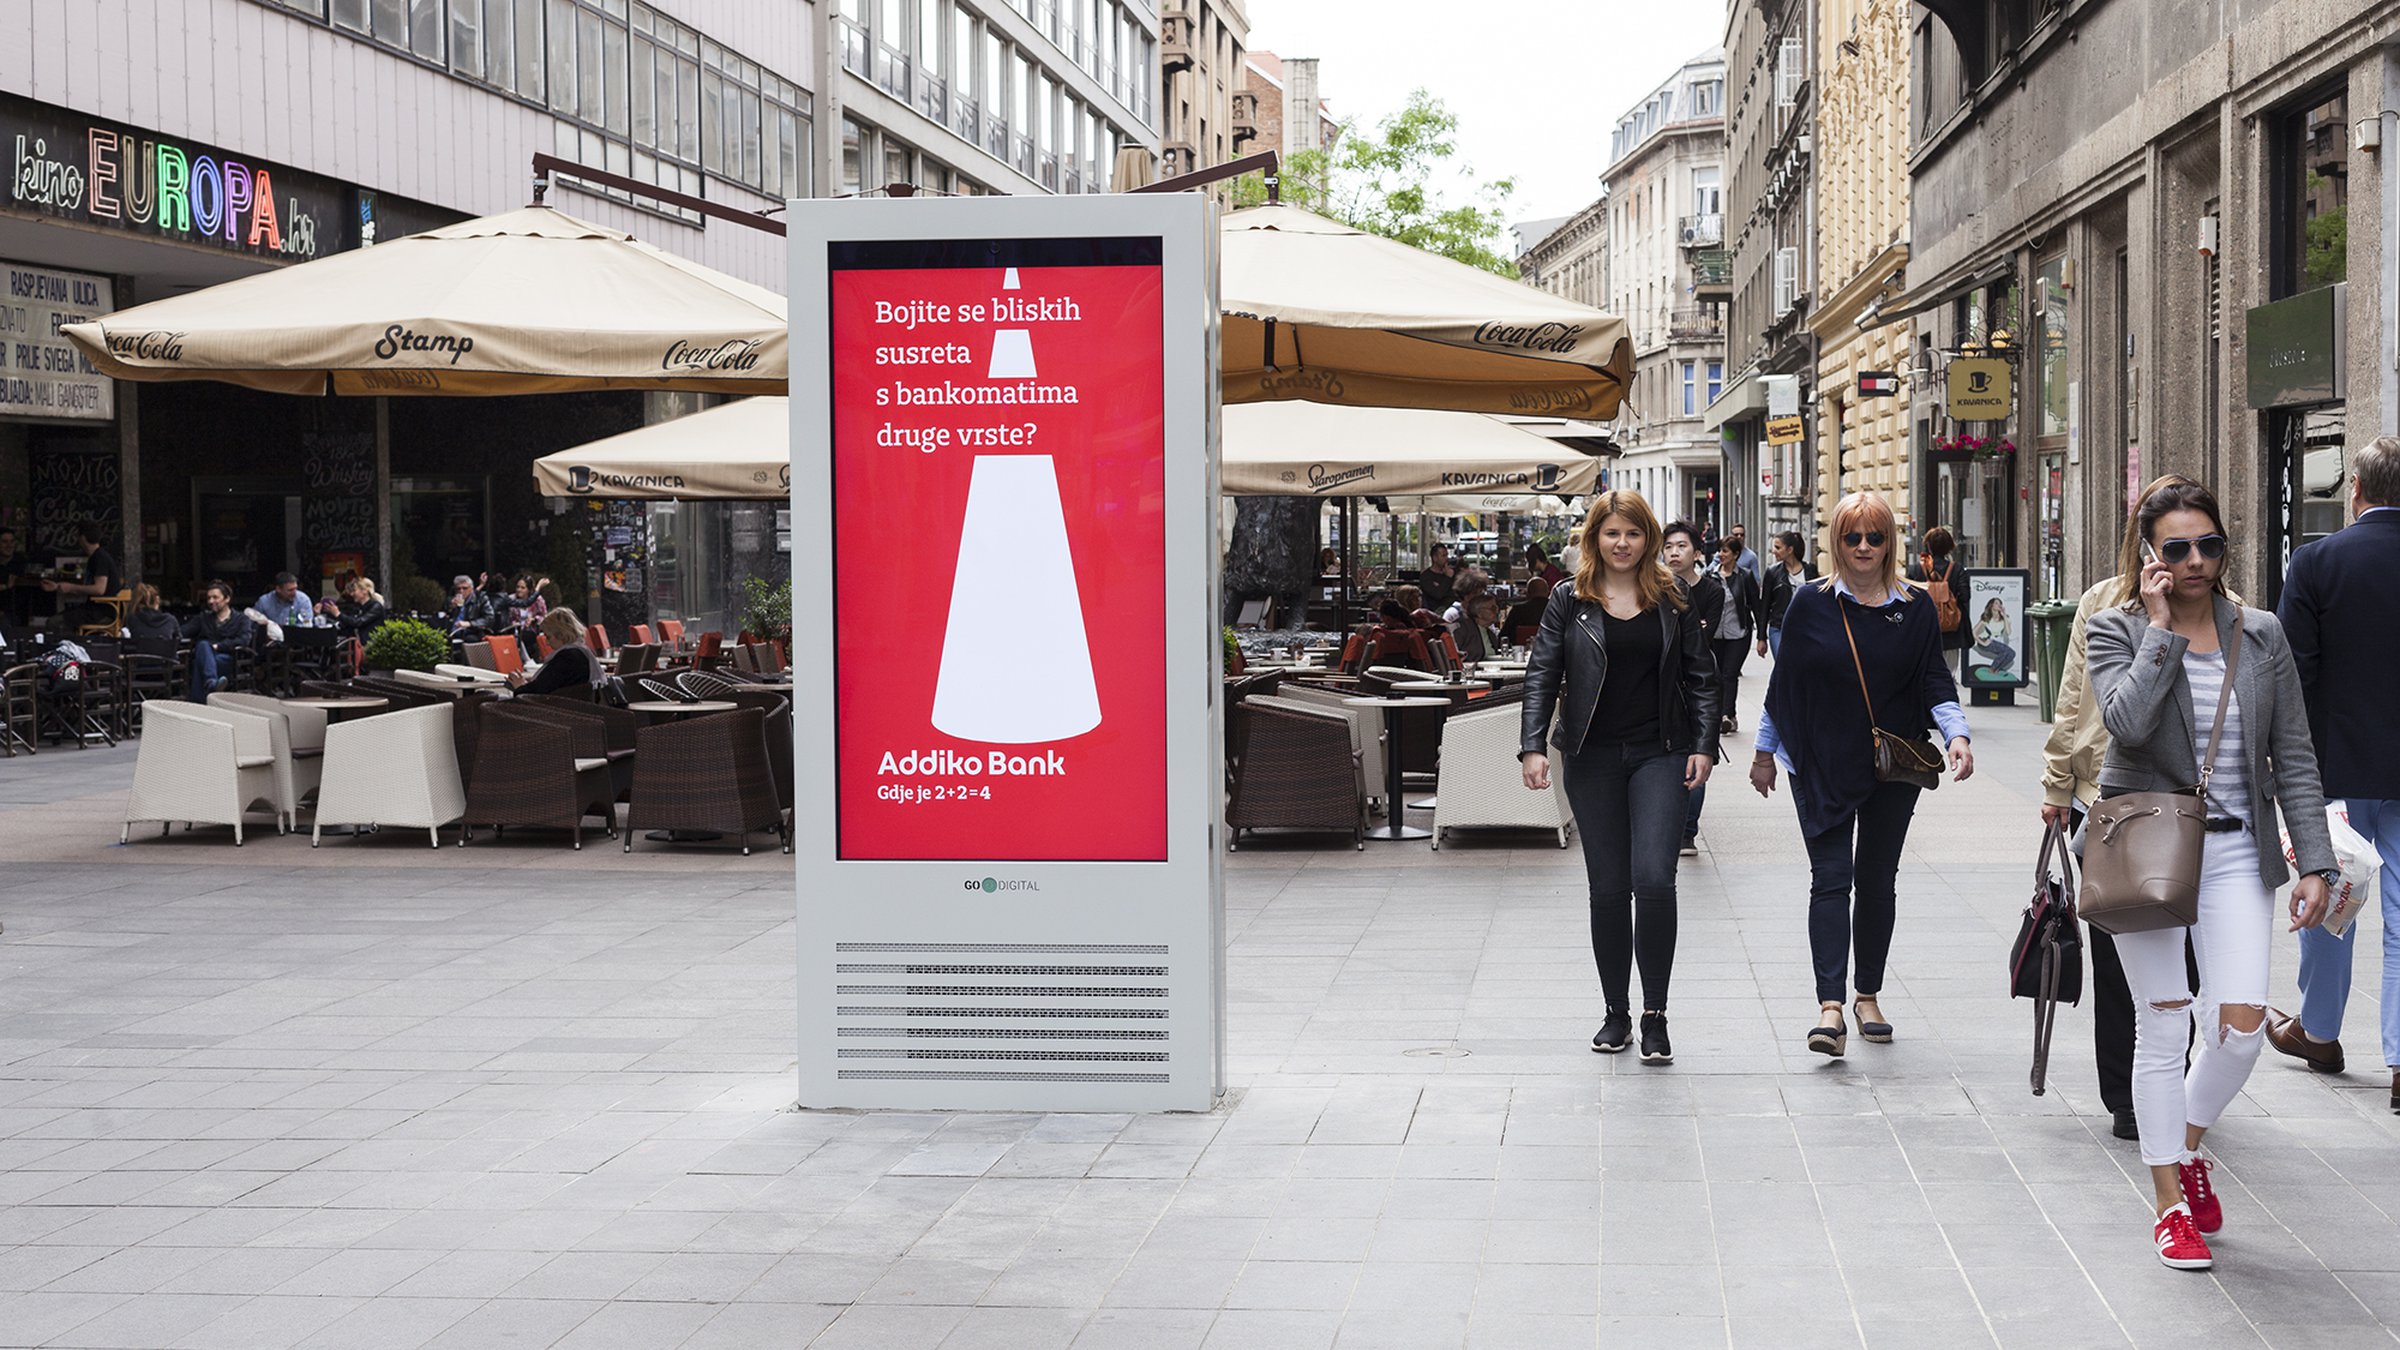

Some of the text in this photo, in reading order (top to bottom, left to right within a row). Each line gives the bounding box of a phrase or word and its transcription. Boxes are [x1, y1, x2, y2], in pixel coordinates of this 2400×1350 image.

[14, 134, 84, 209] kino
[10, 270, 99, 306] RASPJEVANA ULICA
[875, 297, 1082, 330] Bojite se bliskih
[104, 330, 191, 361] oca-Cola
[375, 324, 474, 365] Stamp
[875, 342, 972, 365] susreta
[44, 346, 75, 373] SVEGA
[57, 383, 99, 409] GANGSTER
[876, 381, 1079, 406] s bankomatima
[1957, 398, 2002, 406] KAVANICA
[876, 423, 1037, 453] druge vrste?
[602, 475, 685, 489] KAVANICA
[1308, 464, 1375, 488] Staropramen
[1442, 472, 1529, 486] KAVANICA
[1972, 580, 2005, 594] Disney
[877, 749, 1066, 776] Addiko Bank
[877, 785, 914, 804] Gdje
[916, 785, 932, 803] je
[2333, 881, 2354, 915] KONZUM
